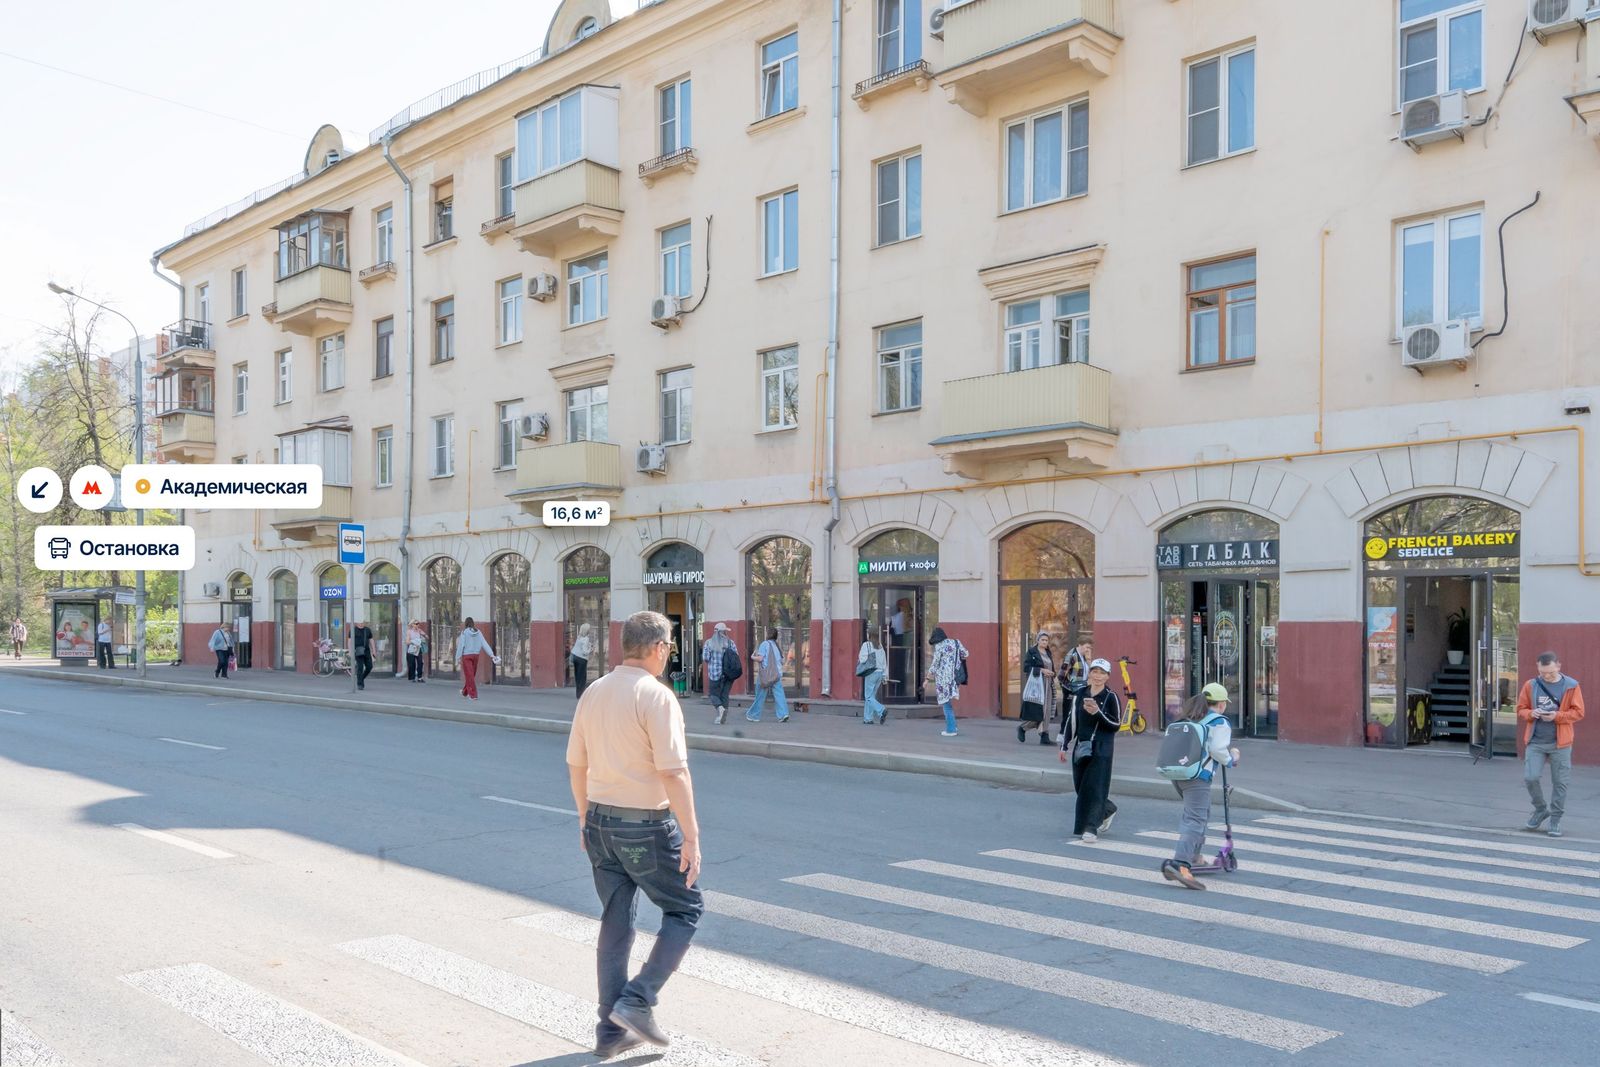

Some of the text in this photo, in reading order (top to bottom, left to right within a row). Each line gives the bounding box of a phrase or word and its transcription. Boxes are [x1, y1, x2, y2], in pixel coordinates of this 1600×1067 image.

[1388, 532, 1516, 549] FRENCH BAKERY
[1158, 546, 1180, 555] TAB
[1190, 542, 1270, 561] ТАБАК
[1398, 547, 1453, 558] SEDELICE
[1158, 555, 1180, 564] LAB
[869, 560, 937, 572] МИЛТИ +кофе
[643, 571, 705, 585] ШАУРМА ГИРОС
[323, 588, 342, 597] OZON
[372, 583, 399, 595] ЦВЕТЫ
